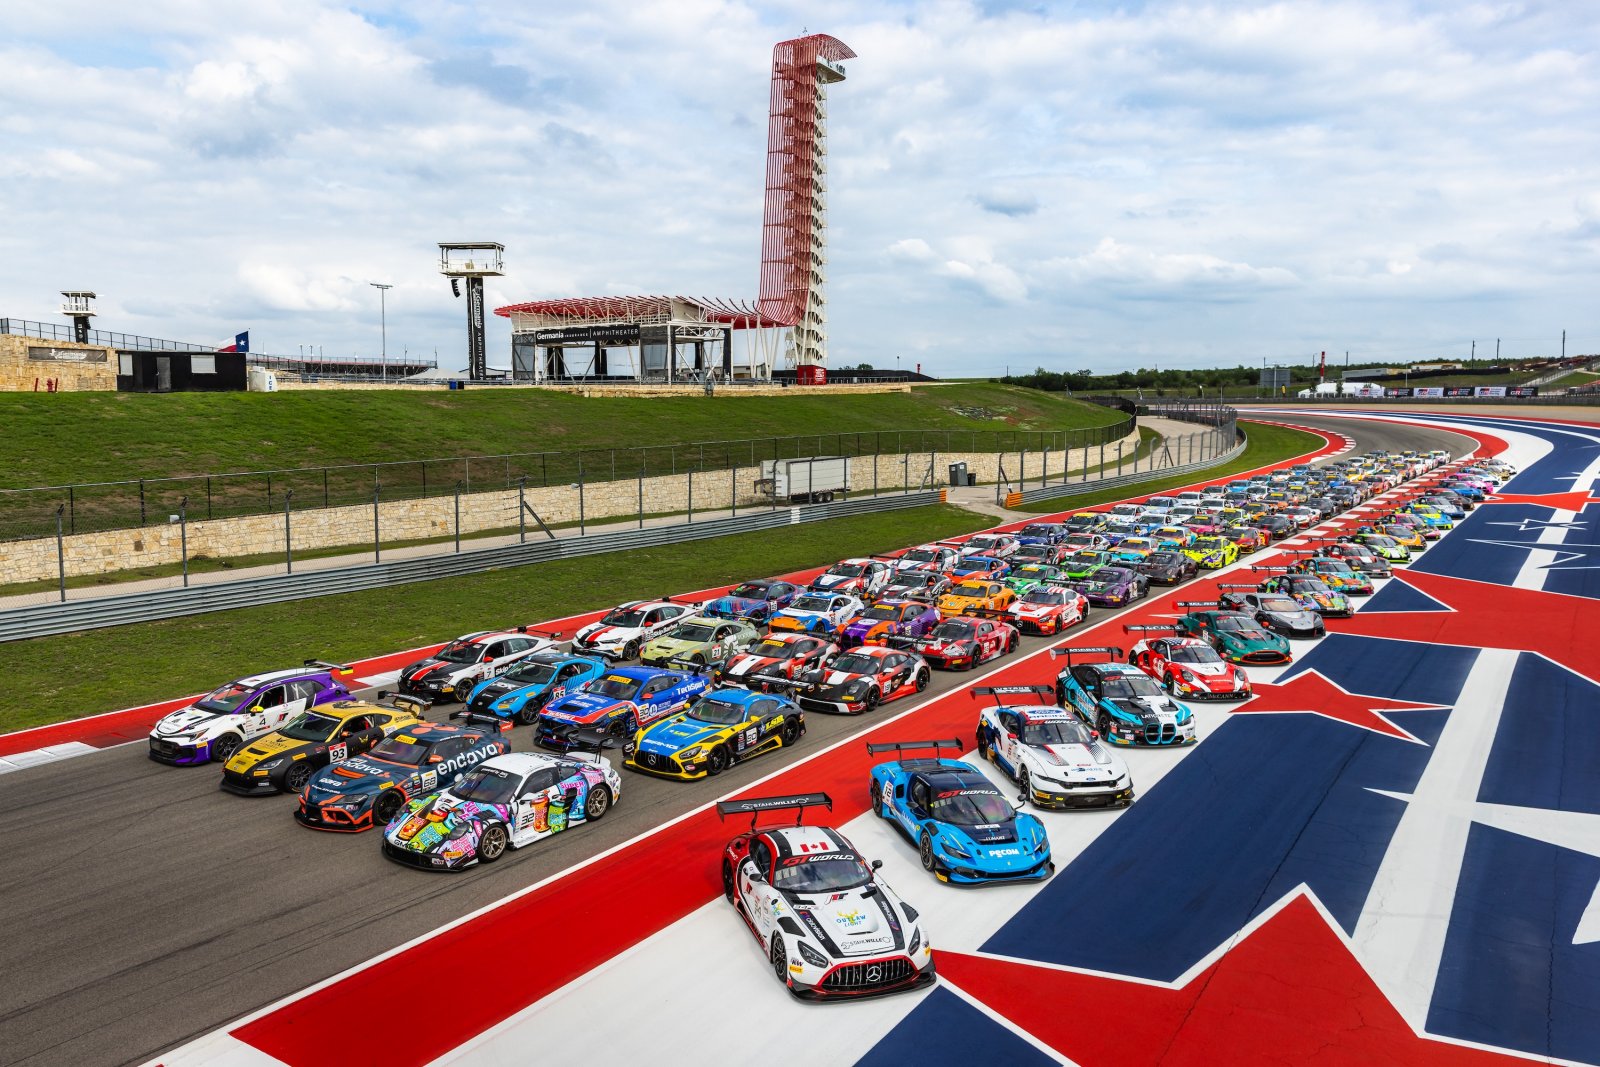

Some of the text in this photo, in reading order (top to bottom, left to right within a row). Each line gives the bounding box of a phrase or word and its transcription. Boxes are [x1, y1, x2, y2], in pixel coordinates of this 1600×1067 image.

[536, 331, 564, 340] Germania
[592, 328, 639, 337] AMPHITHEATER
[713, 648, 720, 657] 21
[495, 666, 509, 675] Skip
[676, 680, 706, 695] TechSport
[259, 717, 266, 726] 4
[332, 748, 345, 761] 93
[437, 743, 498, 776] endava
[559, 781, 585, 790] SUPER
[521, 812, 535, 825] 32
[808, 853, 854, 862] WORLD
[836, 914, 866, 924] OUTLAW
[849, 936, 883, 947] STAHLWILLE
